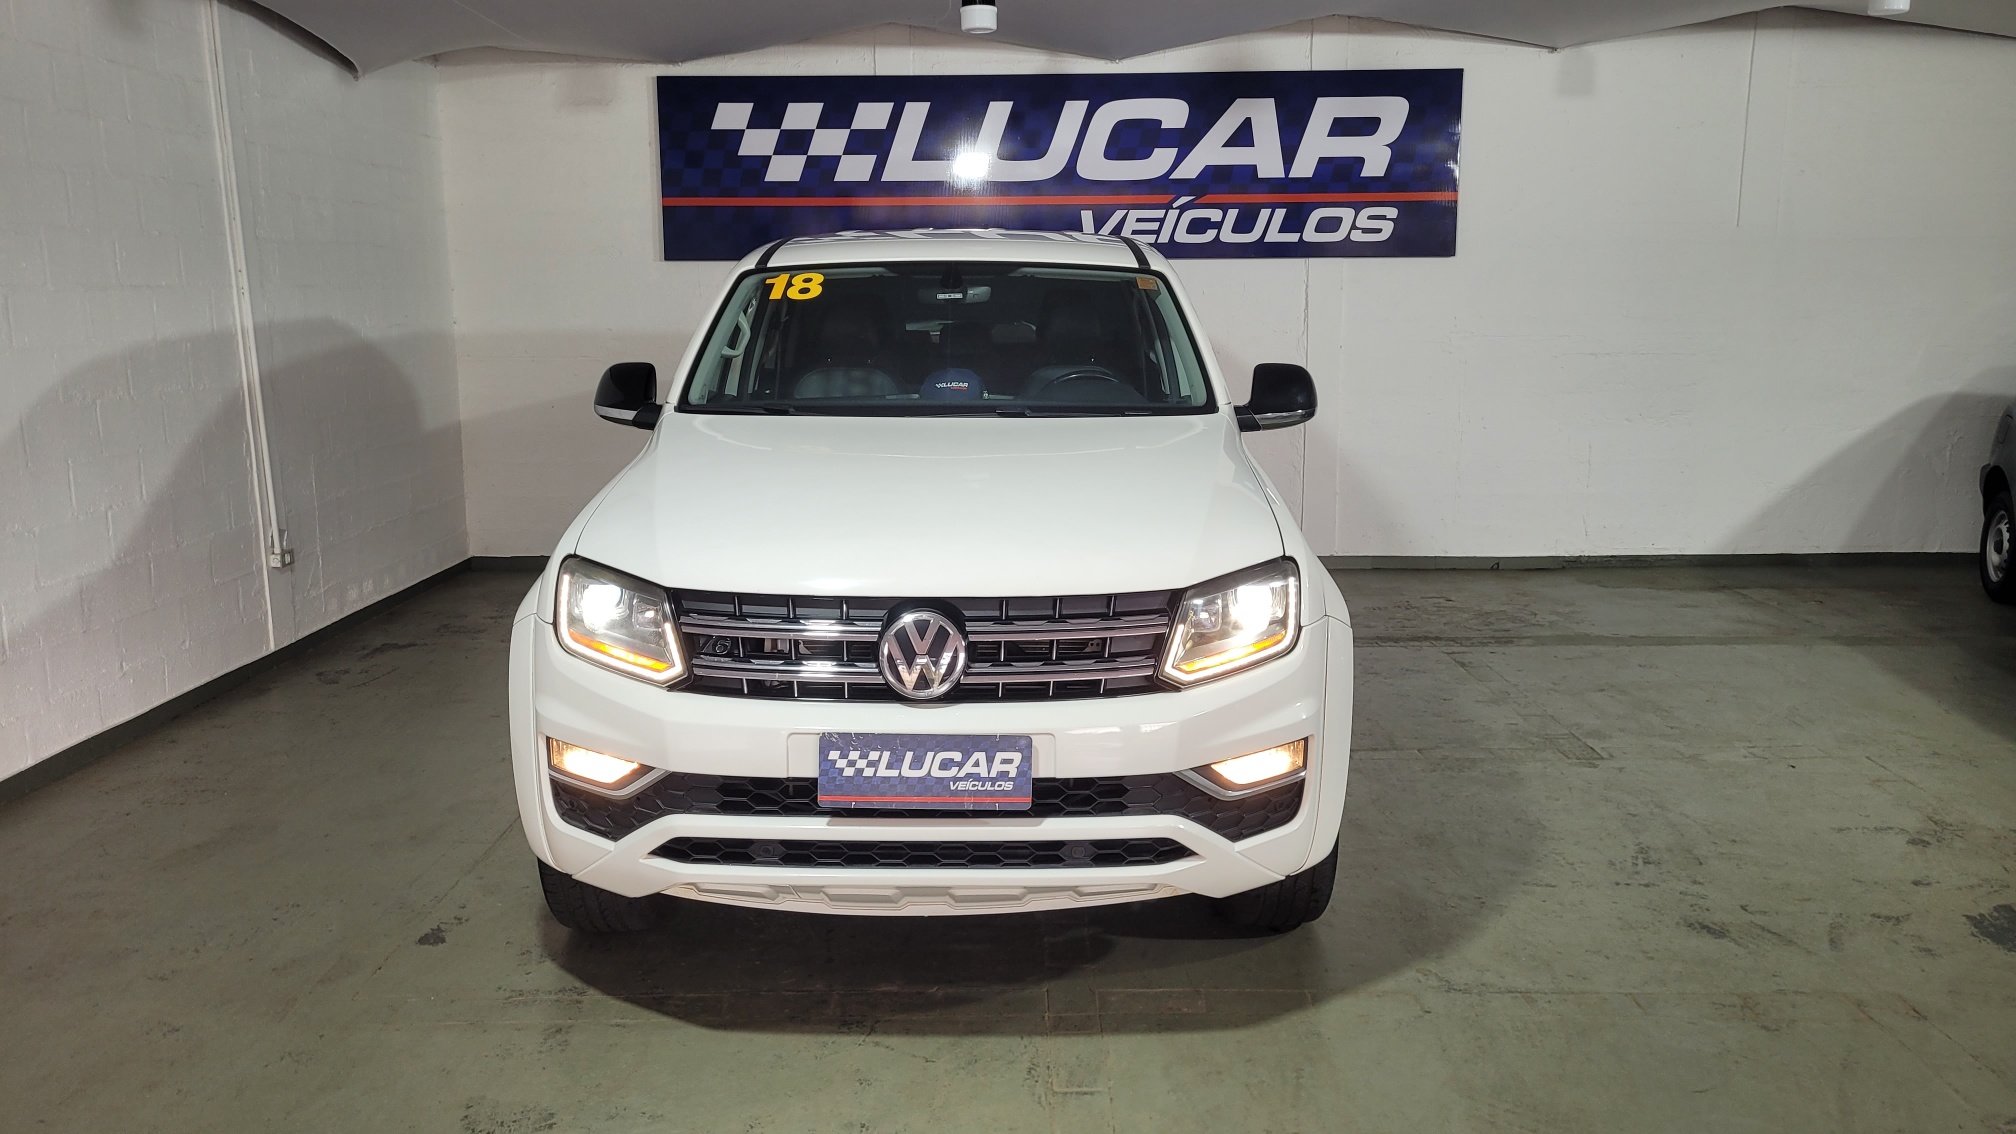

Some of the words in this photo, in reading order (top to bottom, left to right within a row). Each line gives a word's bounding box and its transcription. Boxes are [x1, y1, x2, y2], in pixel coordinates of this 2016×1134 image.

[880, 96, 1410, 182] LUCAR
[1080, 196, 1399, 243] VEÍCULOS
[765, 272, 825, 300] 18
[876, 751, 1023, 778] LUCAR
[950, 778, 1014, 791] VEÍCULOS
